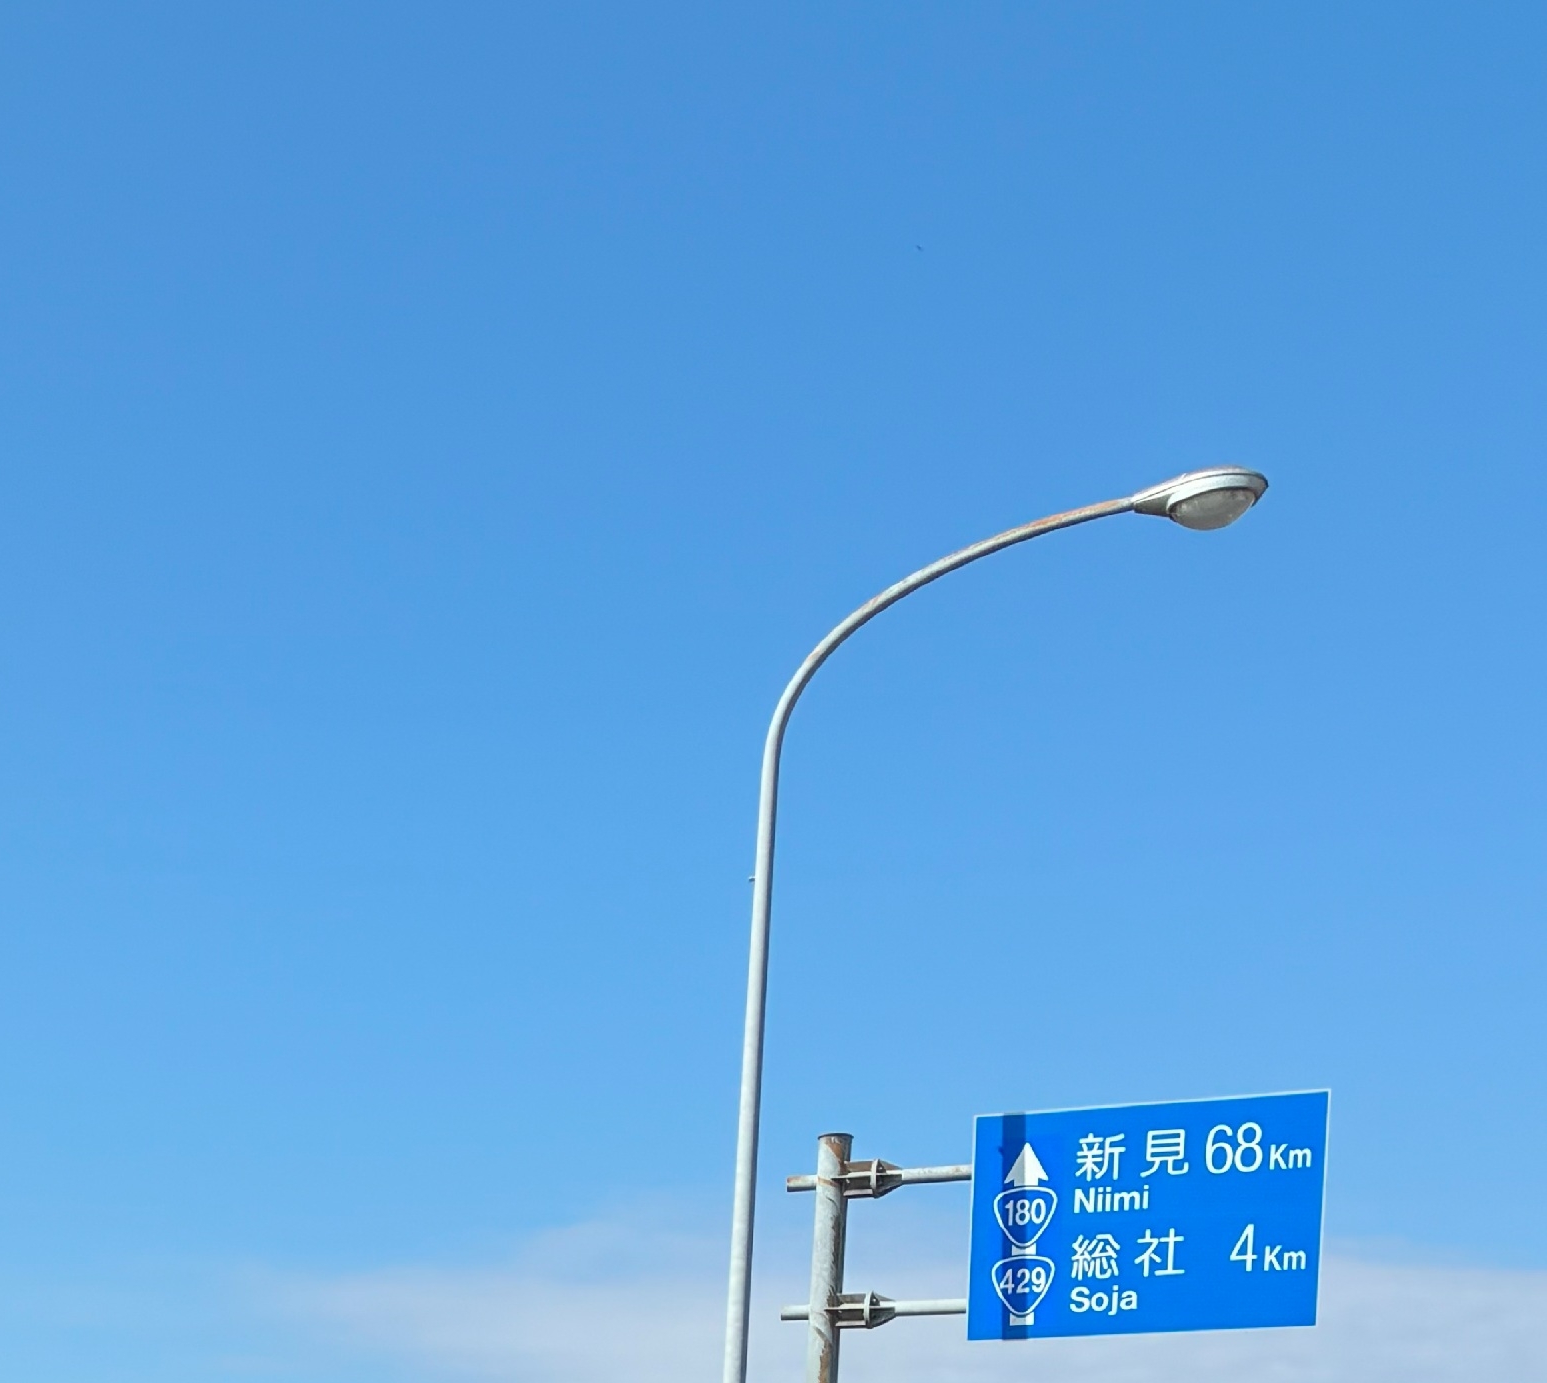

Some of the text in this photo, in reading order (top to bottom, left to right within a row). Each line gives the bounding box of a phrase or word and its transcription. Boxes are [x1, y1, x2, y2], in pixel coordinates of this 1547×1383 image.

[1075, 1129, 1189, 1181] 新見
[1004, 1199, 1046, 1226] 180
[1073, 1185, 1150, 1213] Niimi
[1071, 1228, 1184, 1280] 総社
[999, 1266, 1045, 1295] 429
[1069, 1285, 1138, 1316] Soja
